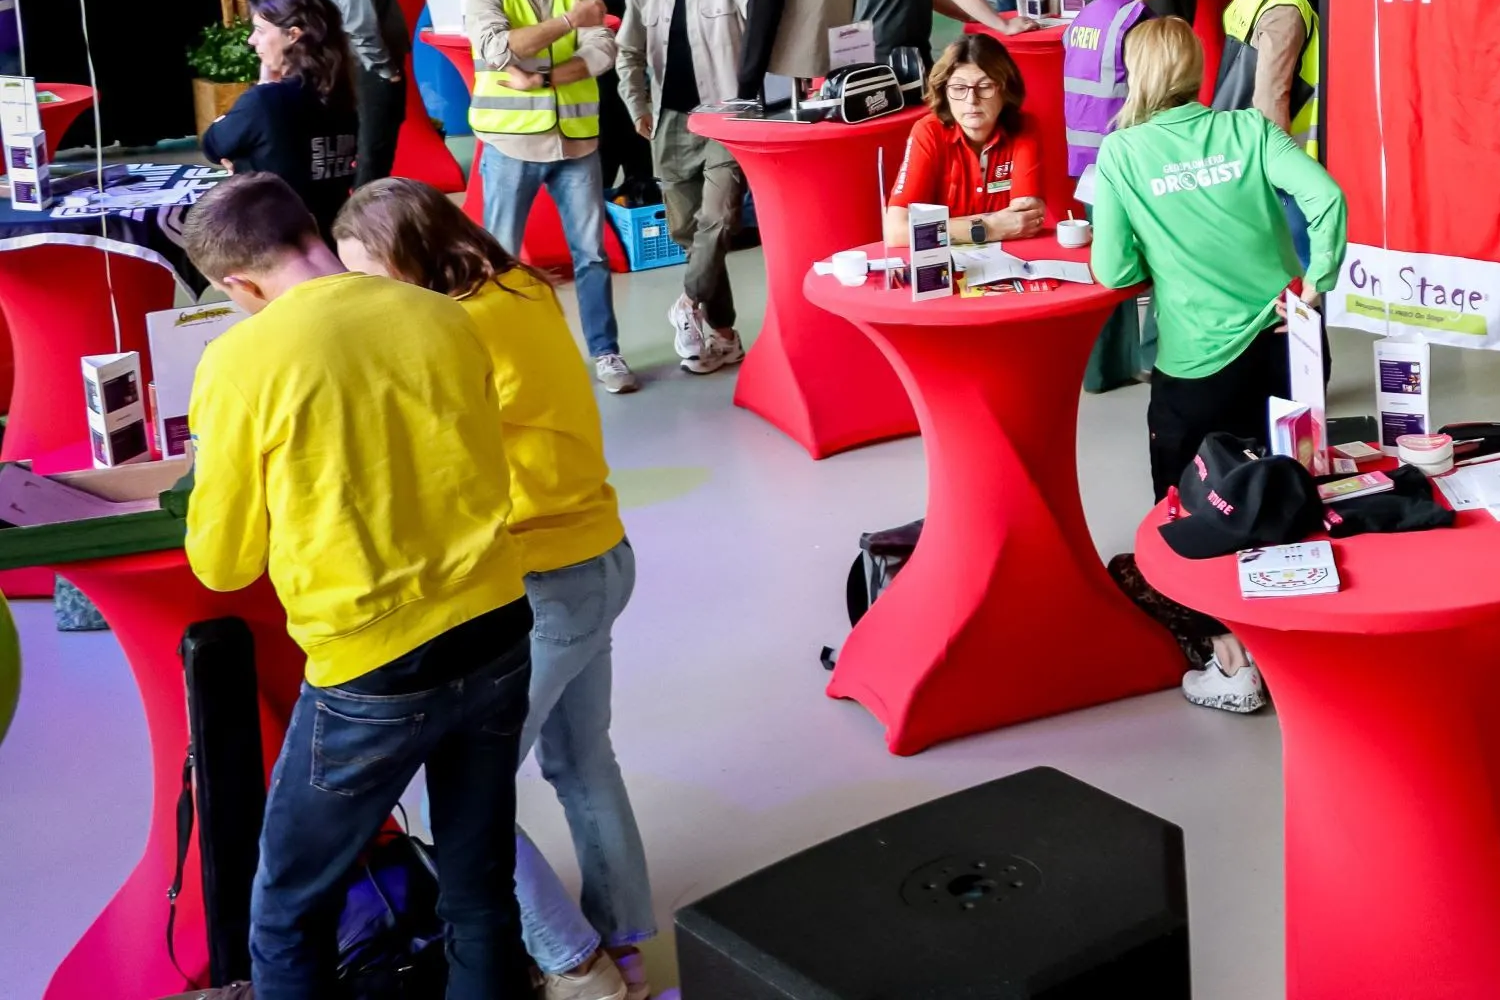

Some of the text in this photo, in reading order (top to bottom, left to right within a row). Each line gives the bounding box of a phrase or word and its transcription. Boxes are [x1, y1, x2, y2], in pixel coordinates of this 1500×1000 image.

[1070, 25, 1101, 51] CREW
[1150, 160, 1243, 197] DROGIST
[1349, 259, 1484, 321] On Stage
